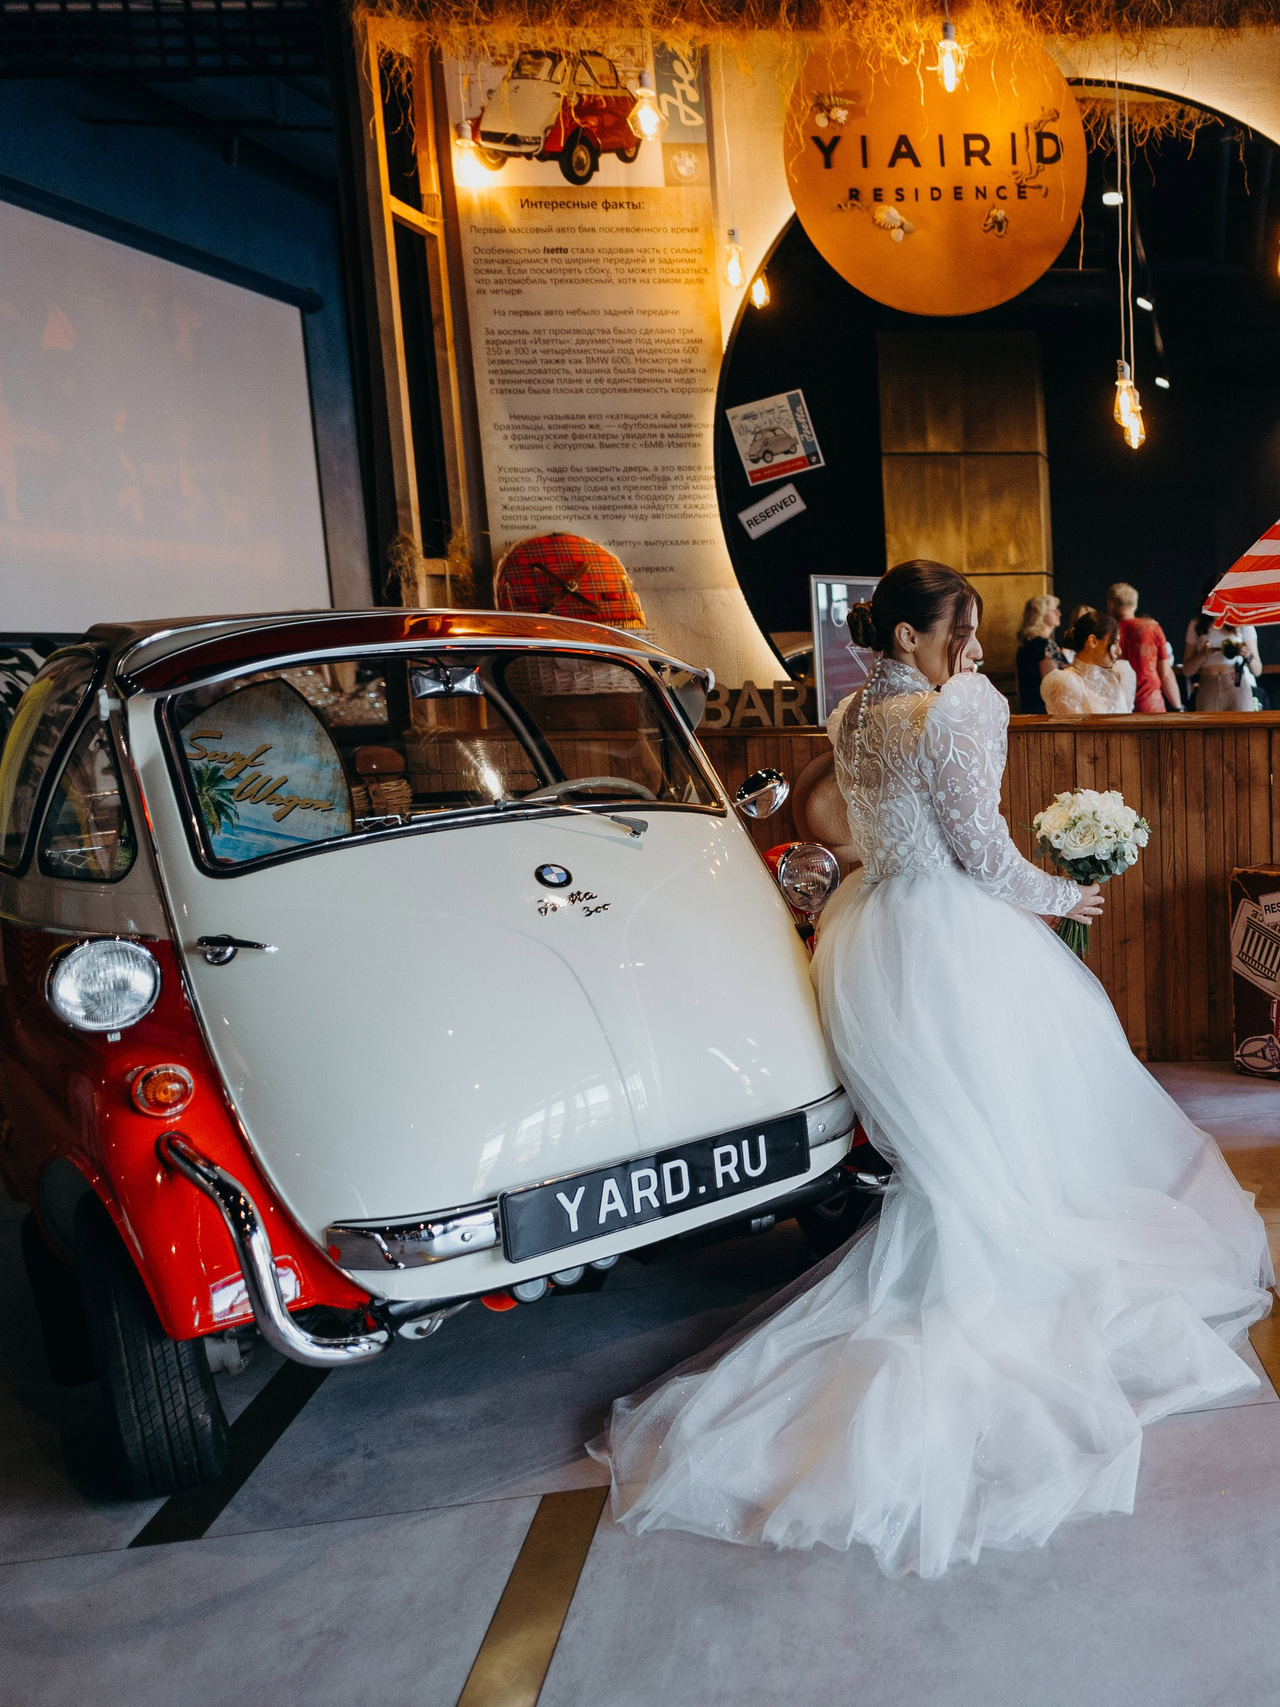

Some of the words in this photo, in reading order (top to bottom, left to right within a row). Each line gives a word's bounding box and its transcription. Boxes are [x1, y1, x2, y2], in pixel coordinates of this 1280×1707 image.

[520, 198, 597, 211] Интересные
[601, 198, 645, 211] факты:
[849, 185, 1028, 203] RESIDENCE
[746, 494, 797, 530] RESERVED
[699, 680, 809, 728] BAR
[186, 730, 272, 780] Surf
[233, 771, 335, 823] Wagon
[556, 1135, 767, 1232] YARD.RU
